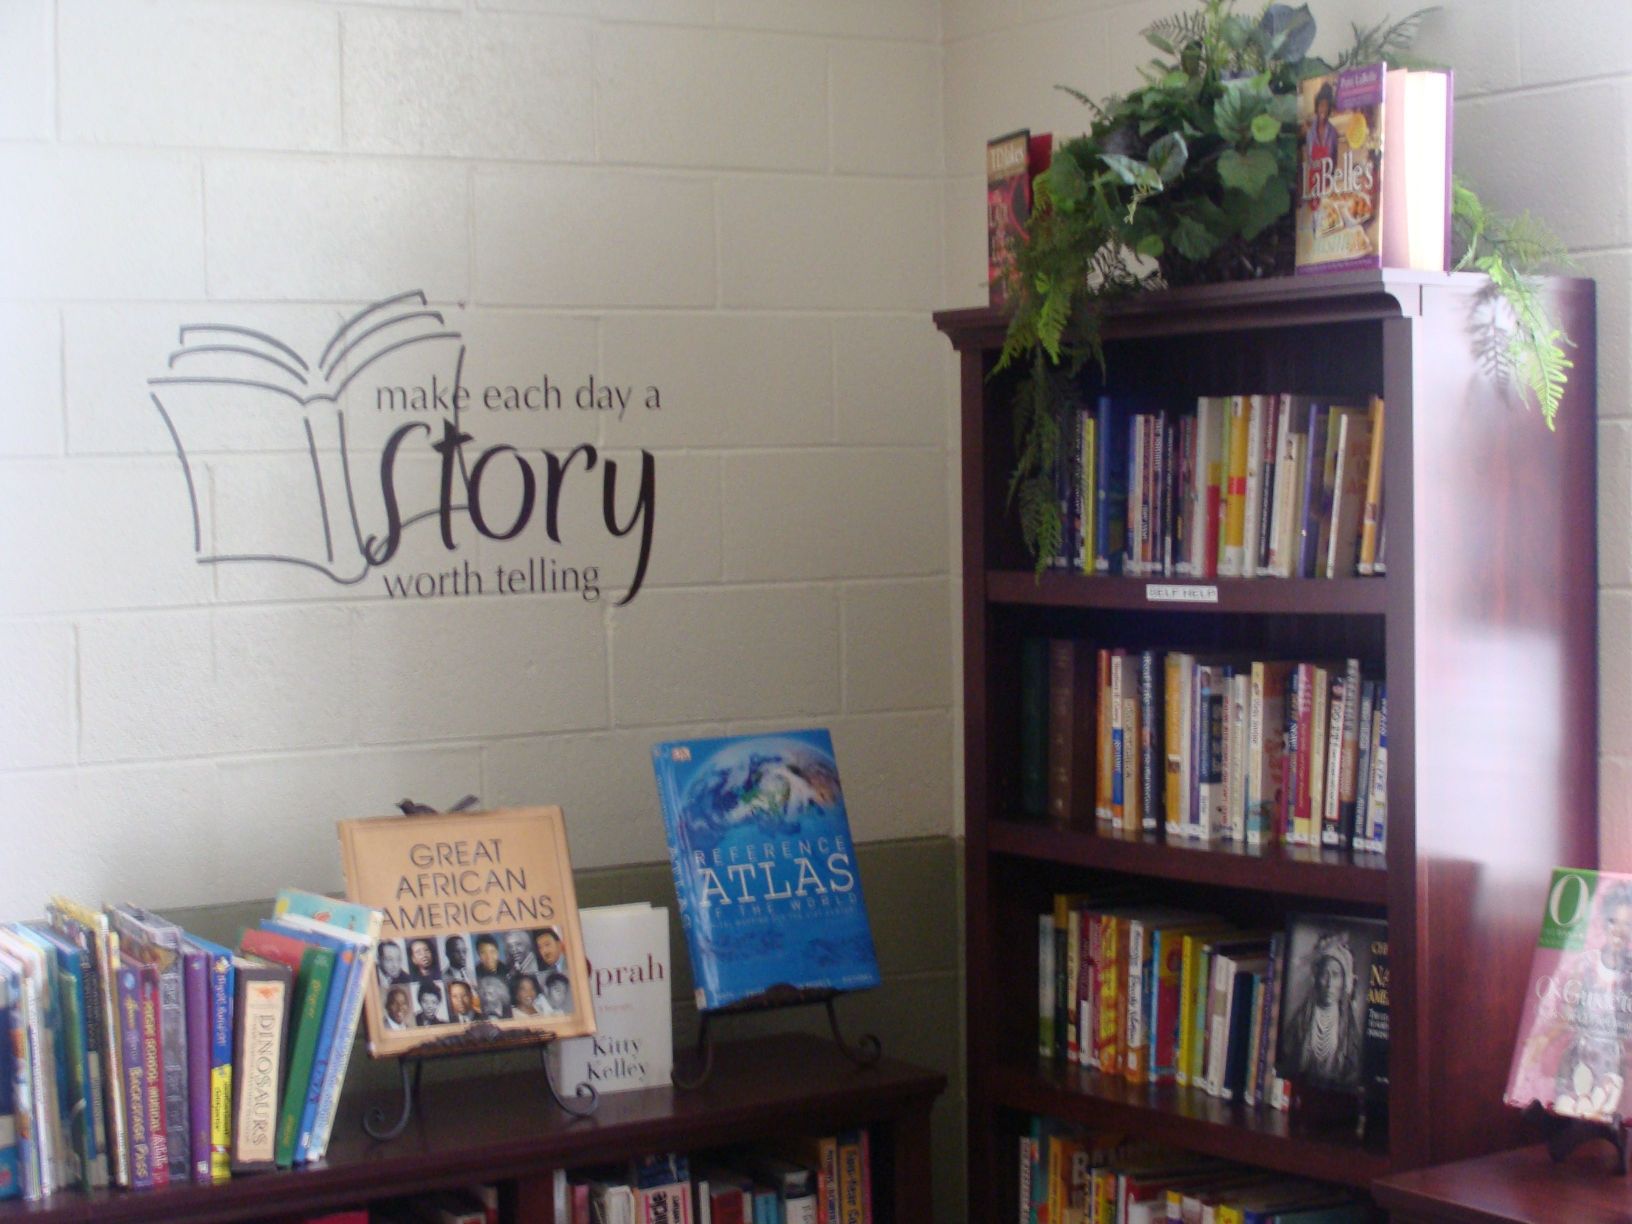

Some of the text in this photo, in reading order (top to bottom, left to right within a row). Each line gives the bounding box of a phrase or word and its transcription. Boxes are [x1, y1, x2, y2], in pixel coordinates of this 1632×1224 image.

[1302, 152, 1373, 199] LaBelle's
[376, 374, 661, 420] make each day a
[383, 559, 600, 602] worth telling
[1183, 587, 1216, 599] HELP
[409, 838, 503, 869] GREAT
[695, 835, 846, 866] REFERENCE
[396, 867, 527, 900] AFRICAN
[698, 853, 855, 907] ATLAS
[380, 895, 555, 931] AMERICANS
[739, 902, 776, 918] THE
[791, 892, 858, 912] WORLD
[1549, 873, 1591, 928] O
[592, 1036, 641, 1060] Kitty
[250, 1013, 276, 1147] DINOSAURS
[587, 1058, 648, 1083] Kelley
